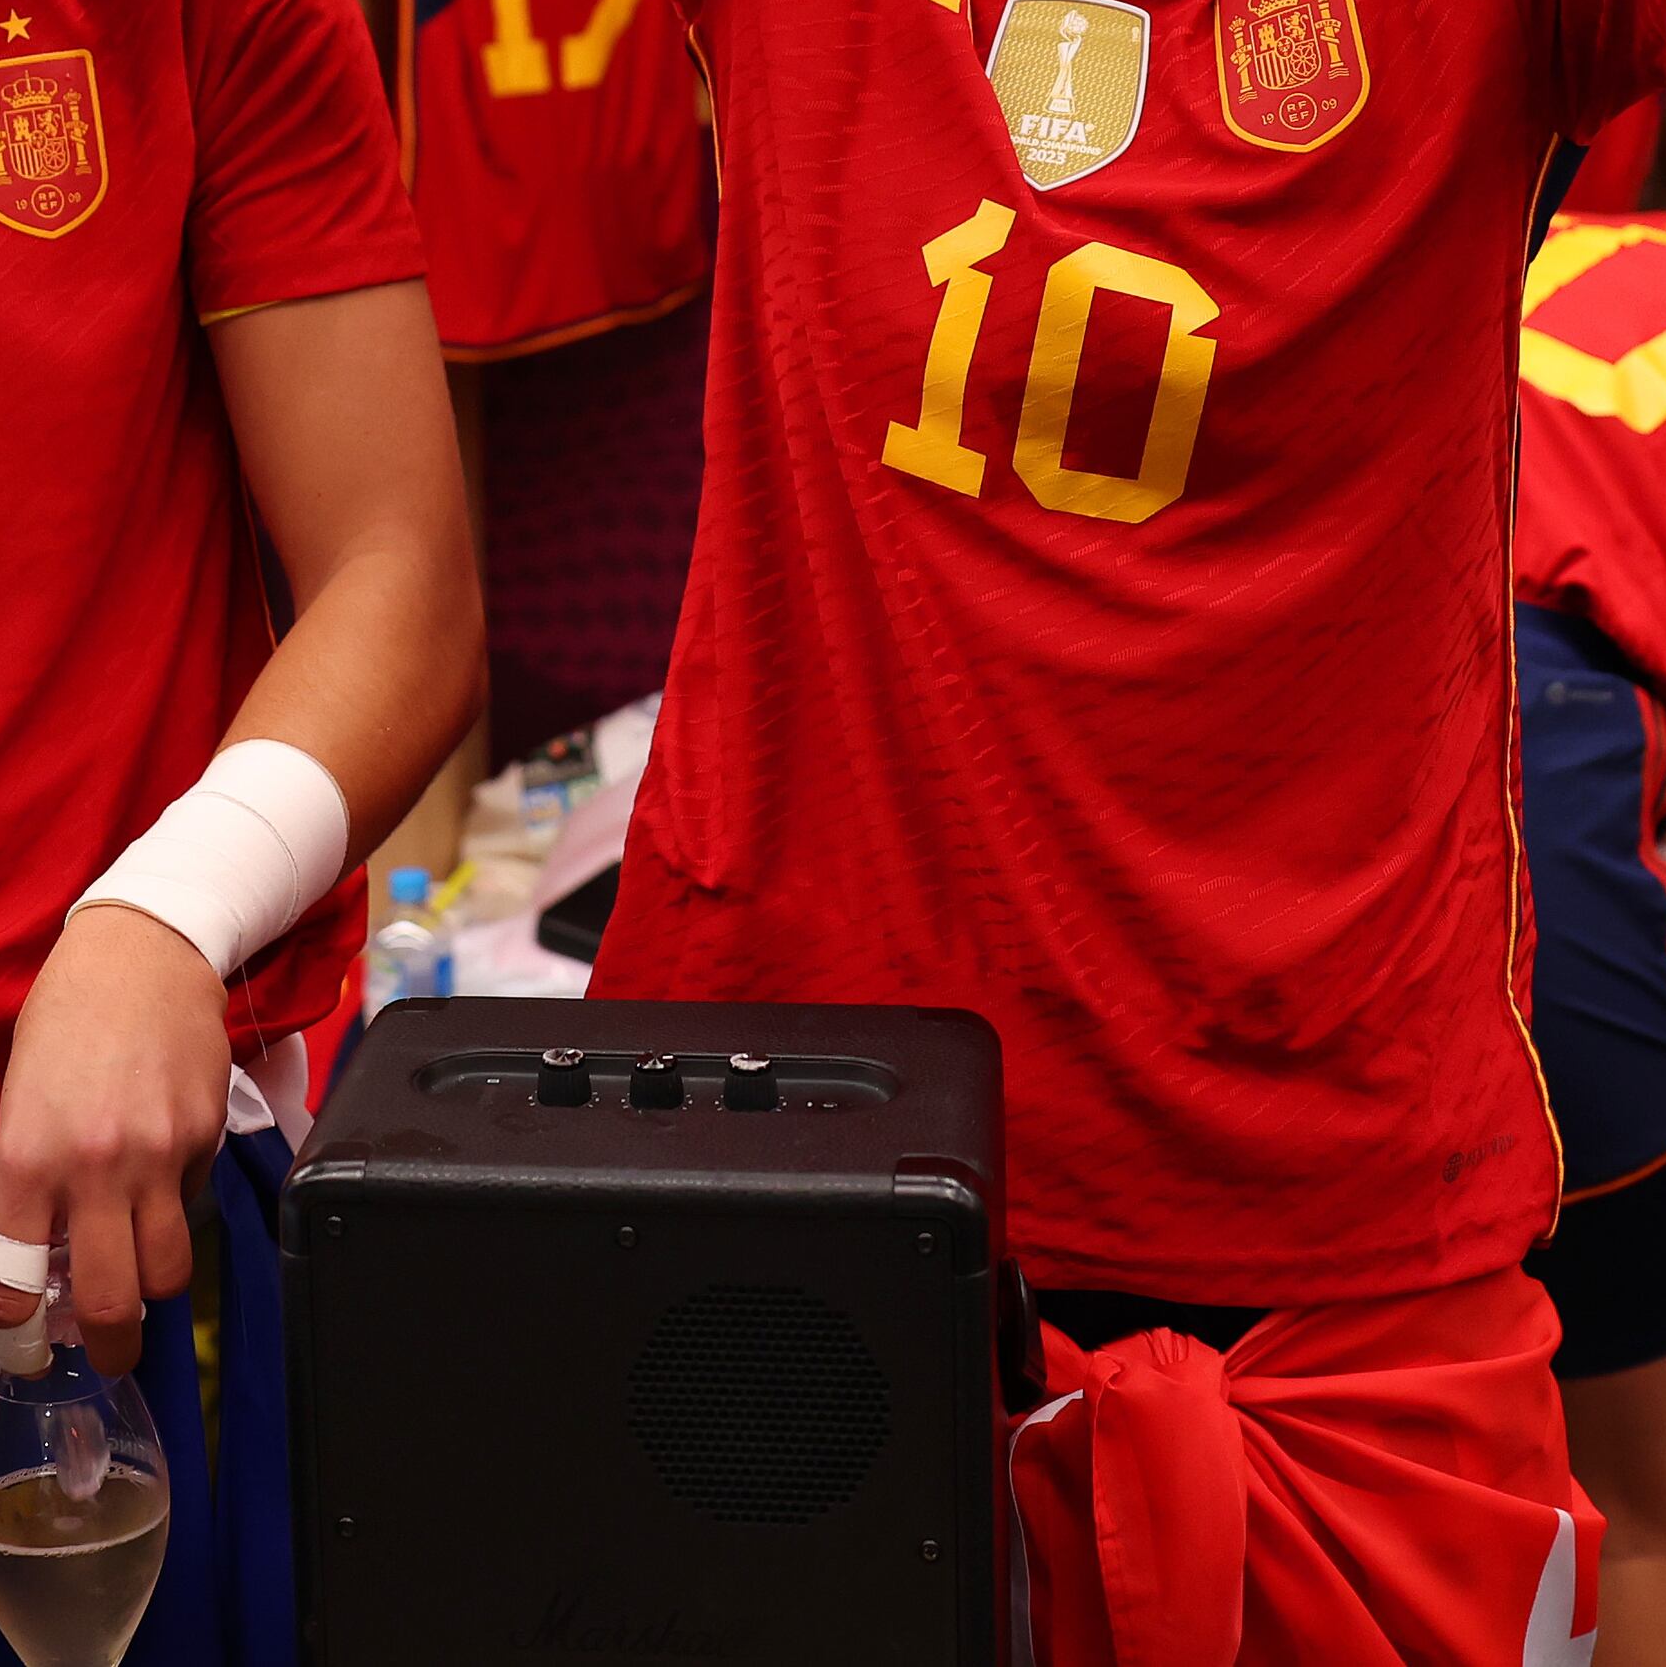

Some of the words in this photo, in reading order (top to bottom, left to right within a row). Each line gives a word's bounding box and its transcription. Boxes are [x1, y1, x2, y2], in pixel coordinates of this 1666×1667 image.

[1020, 114, 1087, 144] FIFA
[1027, 148, 1067, 165] 2023
[1041, 140, 1102, 156] CHAMPIONS
[881, 198, 1221, 523] 10
